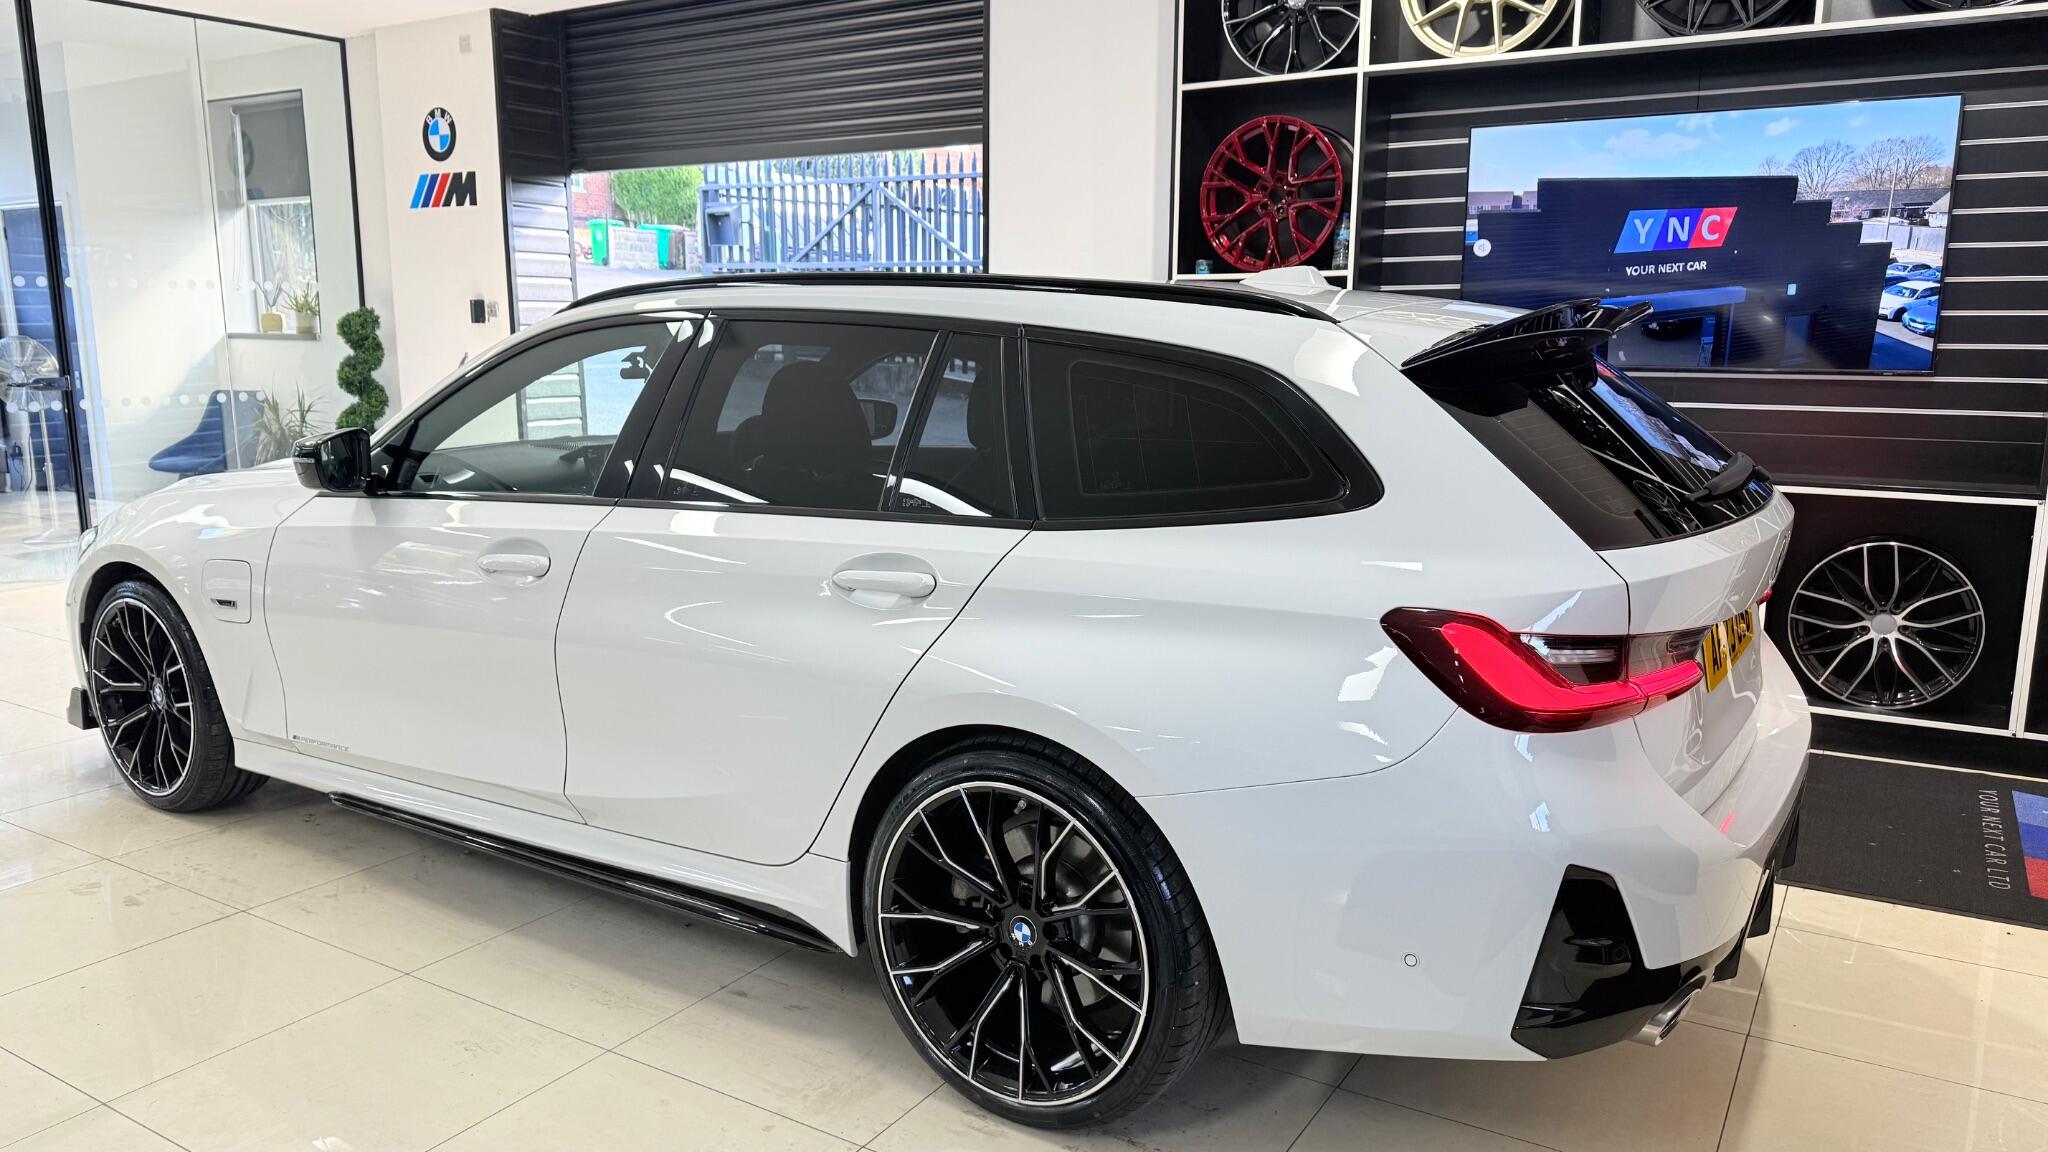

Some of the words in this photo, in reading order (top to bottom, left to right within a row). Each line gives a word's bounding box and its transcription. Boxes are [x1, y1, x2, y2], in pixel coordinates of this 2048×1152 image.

[425, 107, 453, 125] BMW
[1633, 214, 1721, 244] YNC
[1625, 264, 1656, 277] YOUR
[1658, 262, 1685, 274] NEXT
[1686, 260, 1707, 272] CAR
[1978, 789, 2000, 814] YOUR
[1981, 815, 2004, 841] NEXT
[1984, 843, 2007, 865] CAR
[1986, 867, 2011, 890] LTD
